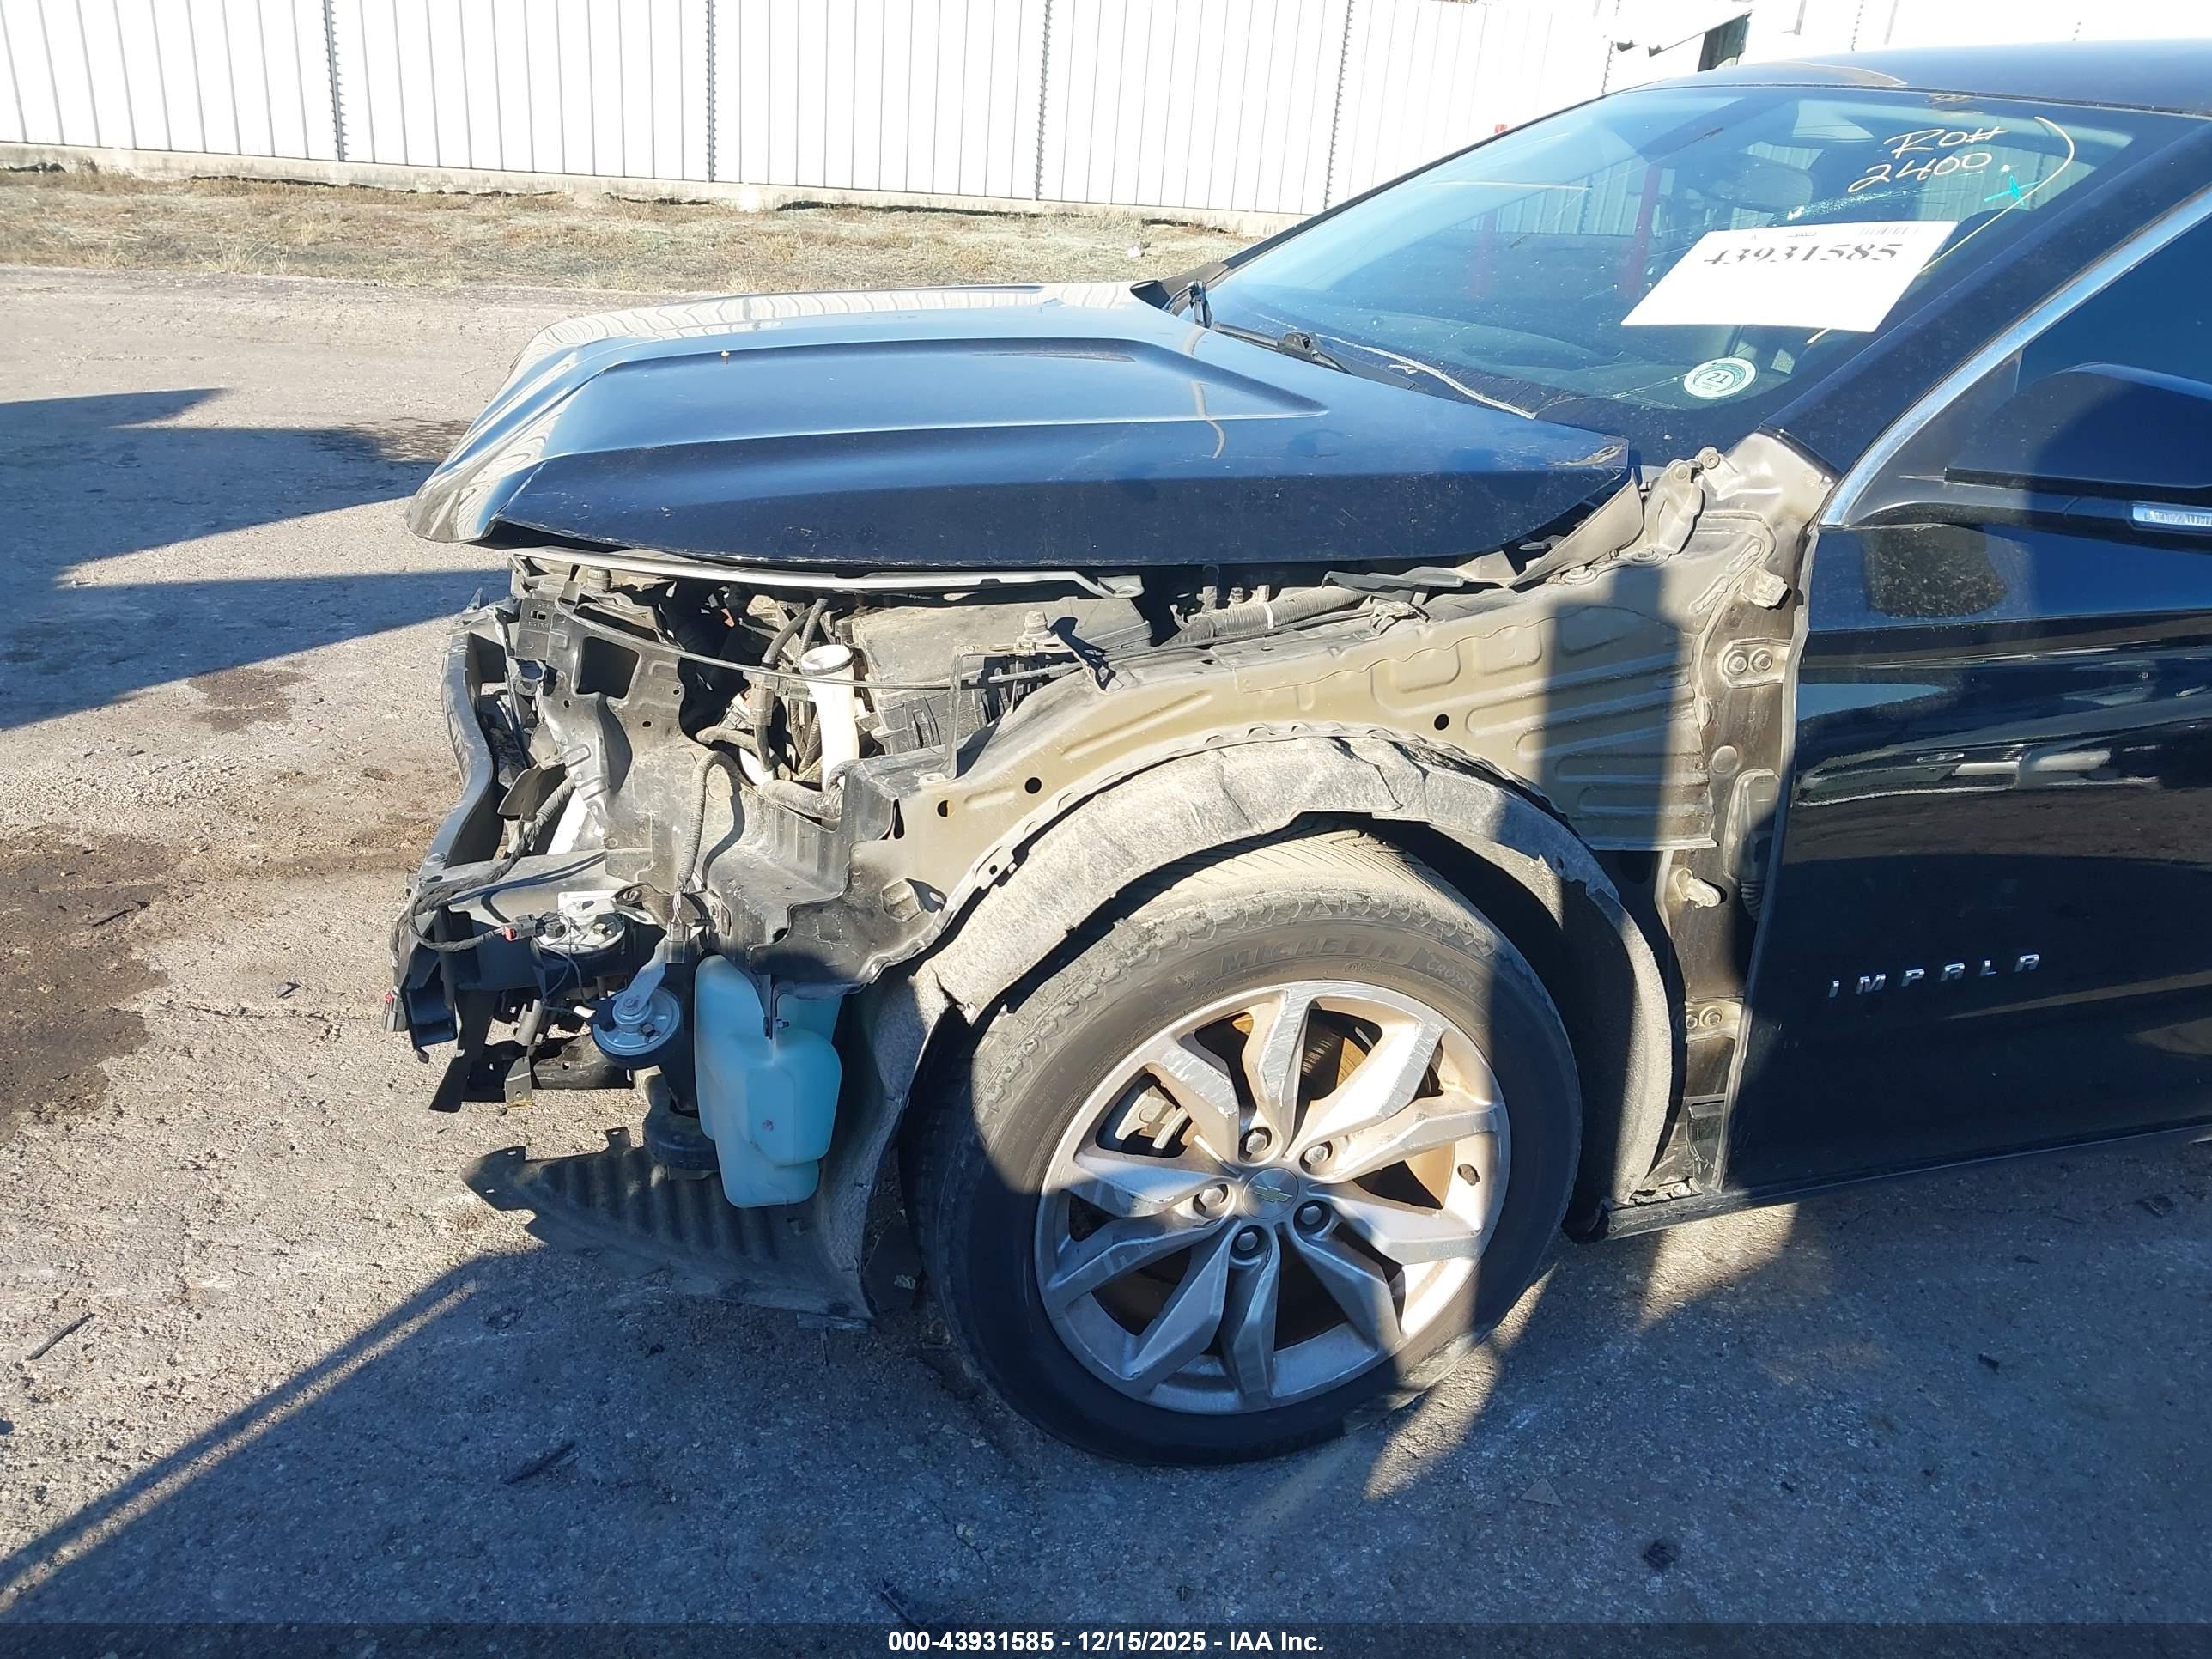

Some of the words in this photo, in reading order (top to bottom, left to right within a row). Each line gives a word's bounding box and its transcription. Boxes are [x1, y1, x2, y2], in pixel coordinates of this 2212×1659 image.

[1704, 243, 1904, 265] 43931585
[1706, 372, 1730, 385] 21
[1219, 935, 1401, 976] MICHELIN
[1828, 953, 2040, 998] IMPALA
